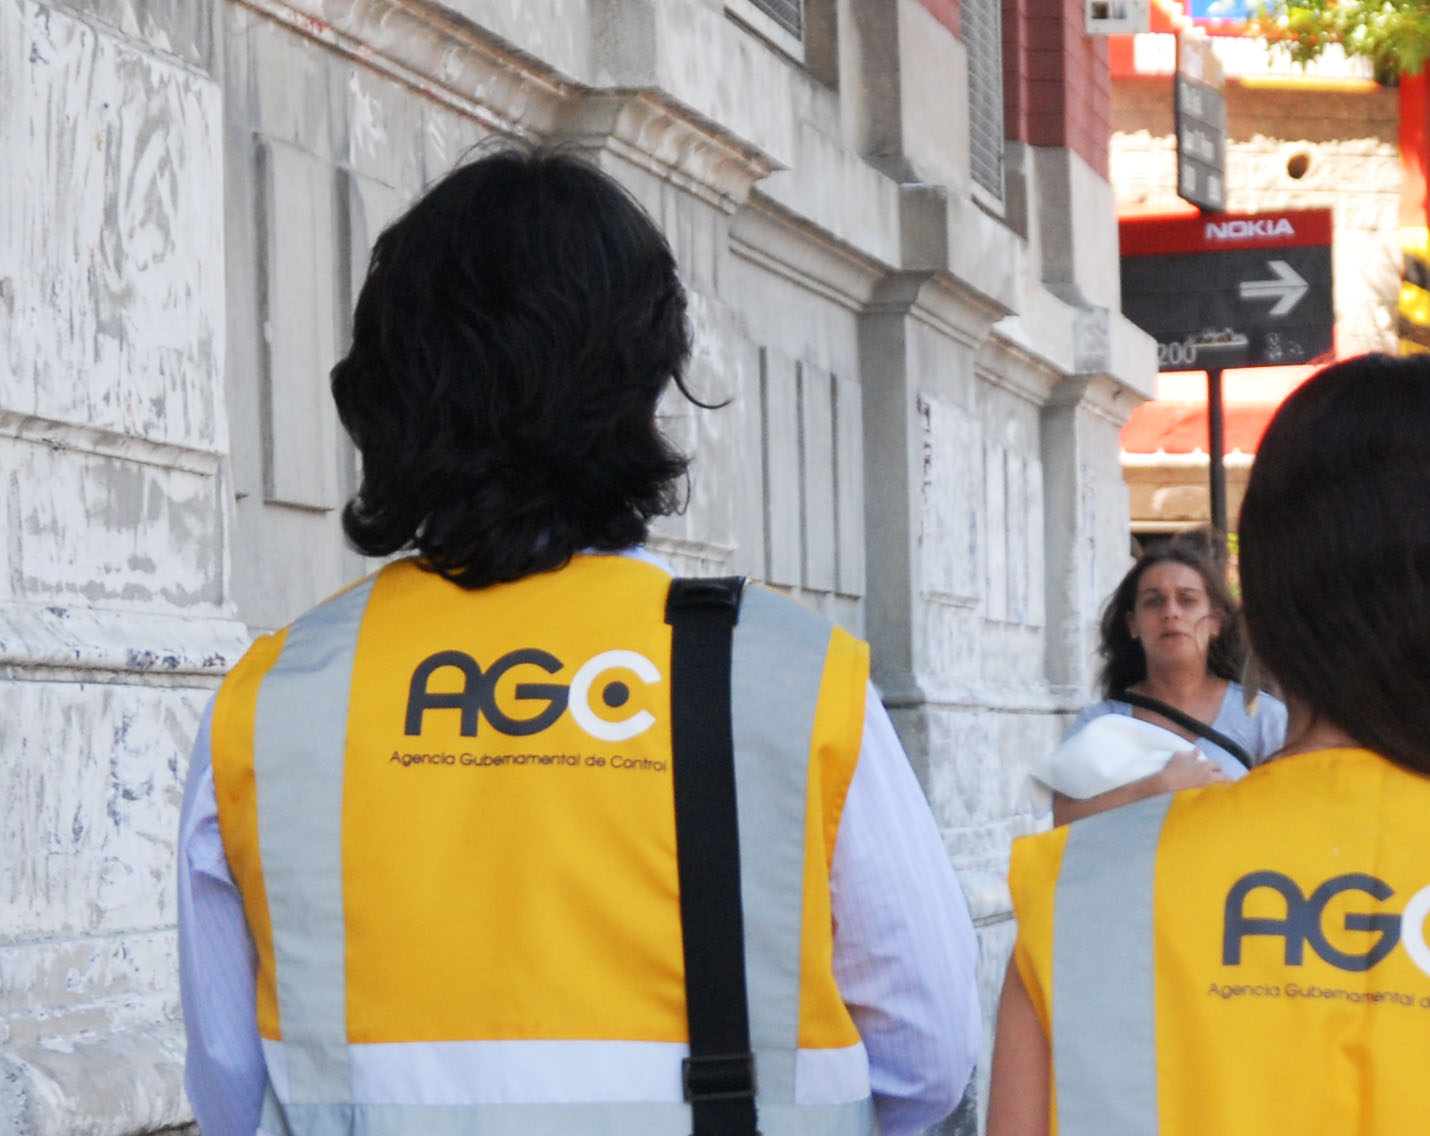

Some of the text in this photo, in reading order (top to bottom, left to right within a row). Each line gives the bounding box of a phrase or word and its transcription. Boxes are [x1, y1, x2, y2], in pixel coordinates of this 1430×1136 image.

[1204, 217, 1296, 240] NOKIA
[1158, 341, 1197, 365] 200
[404, 647, 662, 742] AGC
[390, 751, 456, 768] Agencia
[459, 752, 580, 768] Gubernamental
[584, 754, 606, 769] de
[1207, 983, 1281, 999] Agencia
[1285, 983, 1415, 1006] Gubernamental
